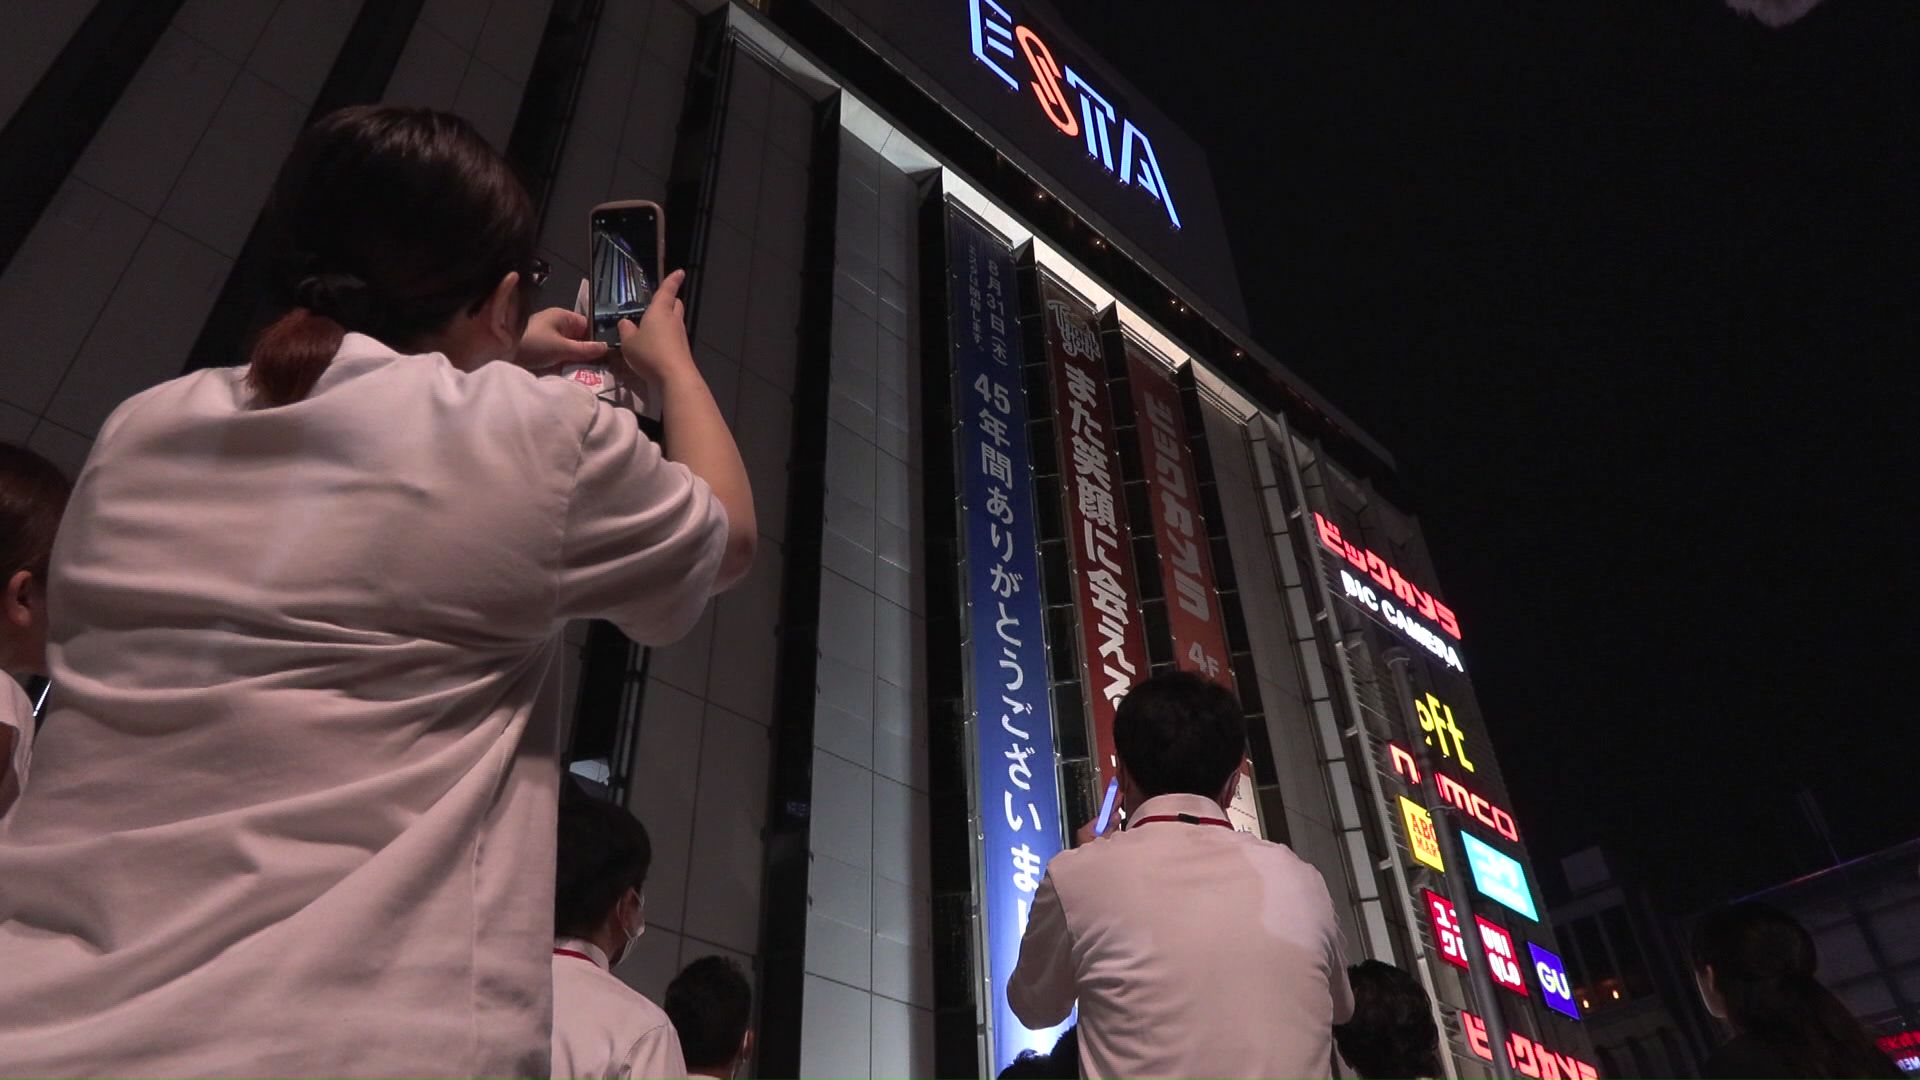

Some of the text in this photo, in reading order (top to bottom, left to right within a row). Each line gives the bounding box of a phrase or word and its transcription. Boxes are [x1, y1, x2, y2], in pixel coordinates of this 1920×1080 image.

[968, 0, 1182, 229] ESTA
[1314, 511, 1462, 641] ビックカメラ
[1340, 569, 1464, 673] BIC CAMERA
[1479, 923, 1511, 959] UNI
[1488, 952, 1520, 987] QLO
[1537, 961, 1570, 1000] GU
